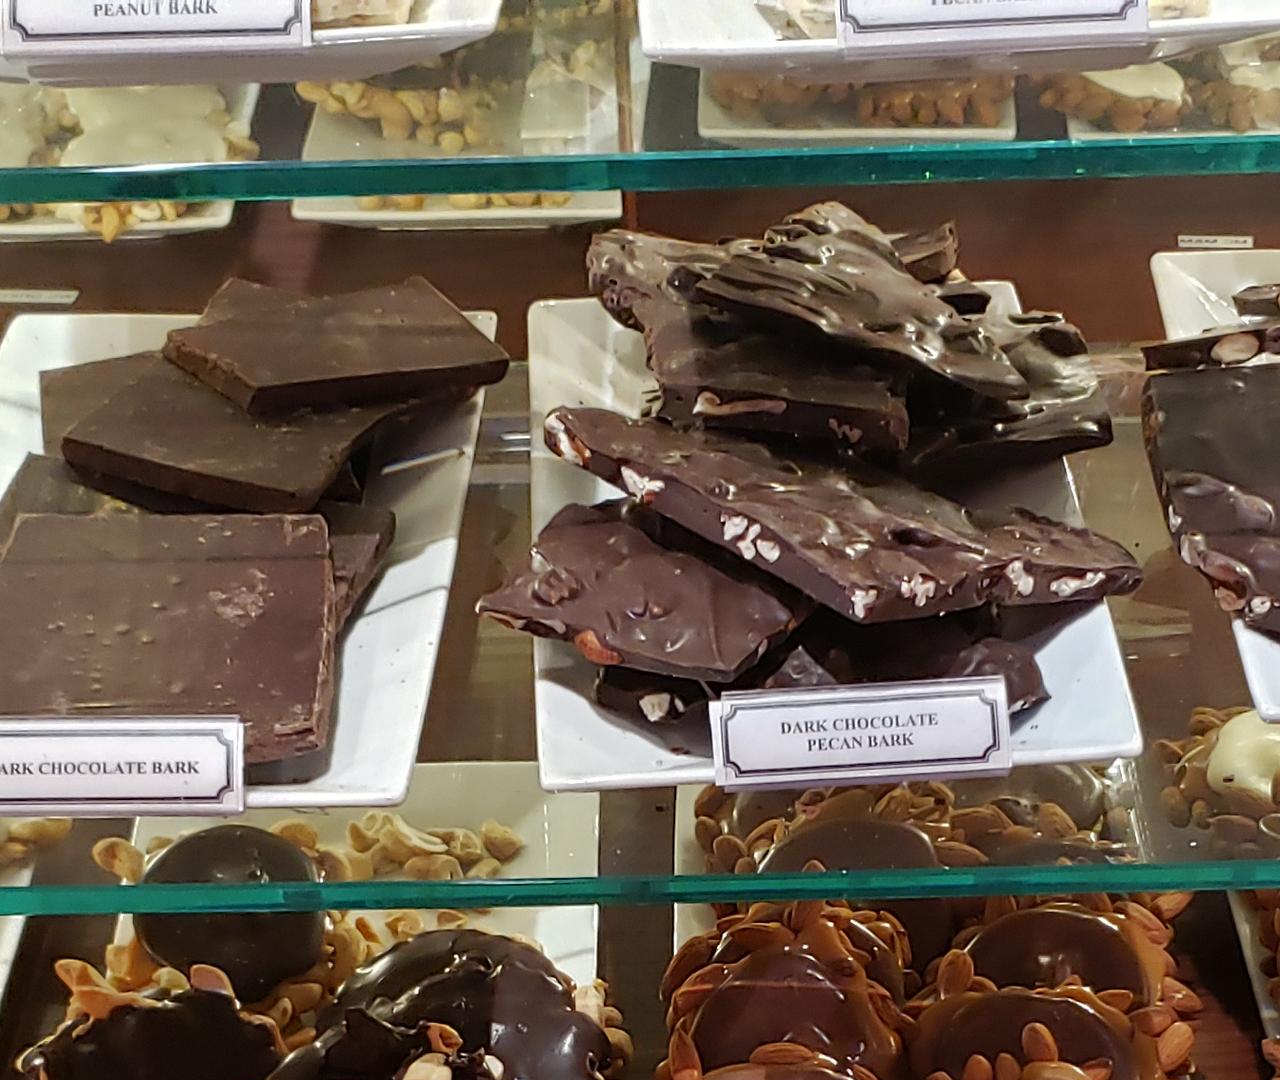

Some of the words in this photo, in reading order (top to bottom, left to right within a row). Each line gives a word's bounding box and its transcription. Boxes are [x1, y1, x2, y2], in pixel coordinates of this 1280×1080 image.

[94, 1, 163, 17] PEANUT
[169, 0, 217, 15] BARK
[781, 720, 828, 734] DARK
[833, 713, 938, 732] CHOCOLATE
[807, 736, 862, 751] PECAN
[868, 733, 914, 747] BARK
[39, 761, 146, 775] CHOCOLATE
[153, 761, 199, 774] BARK
